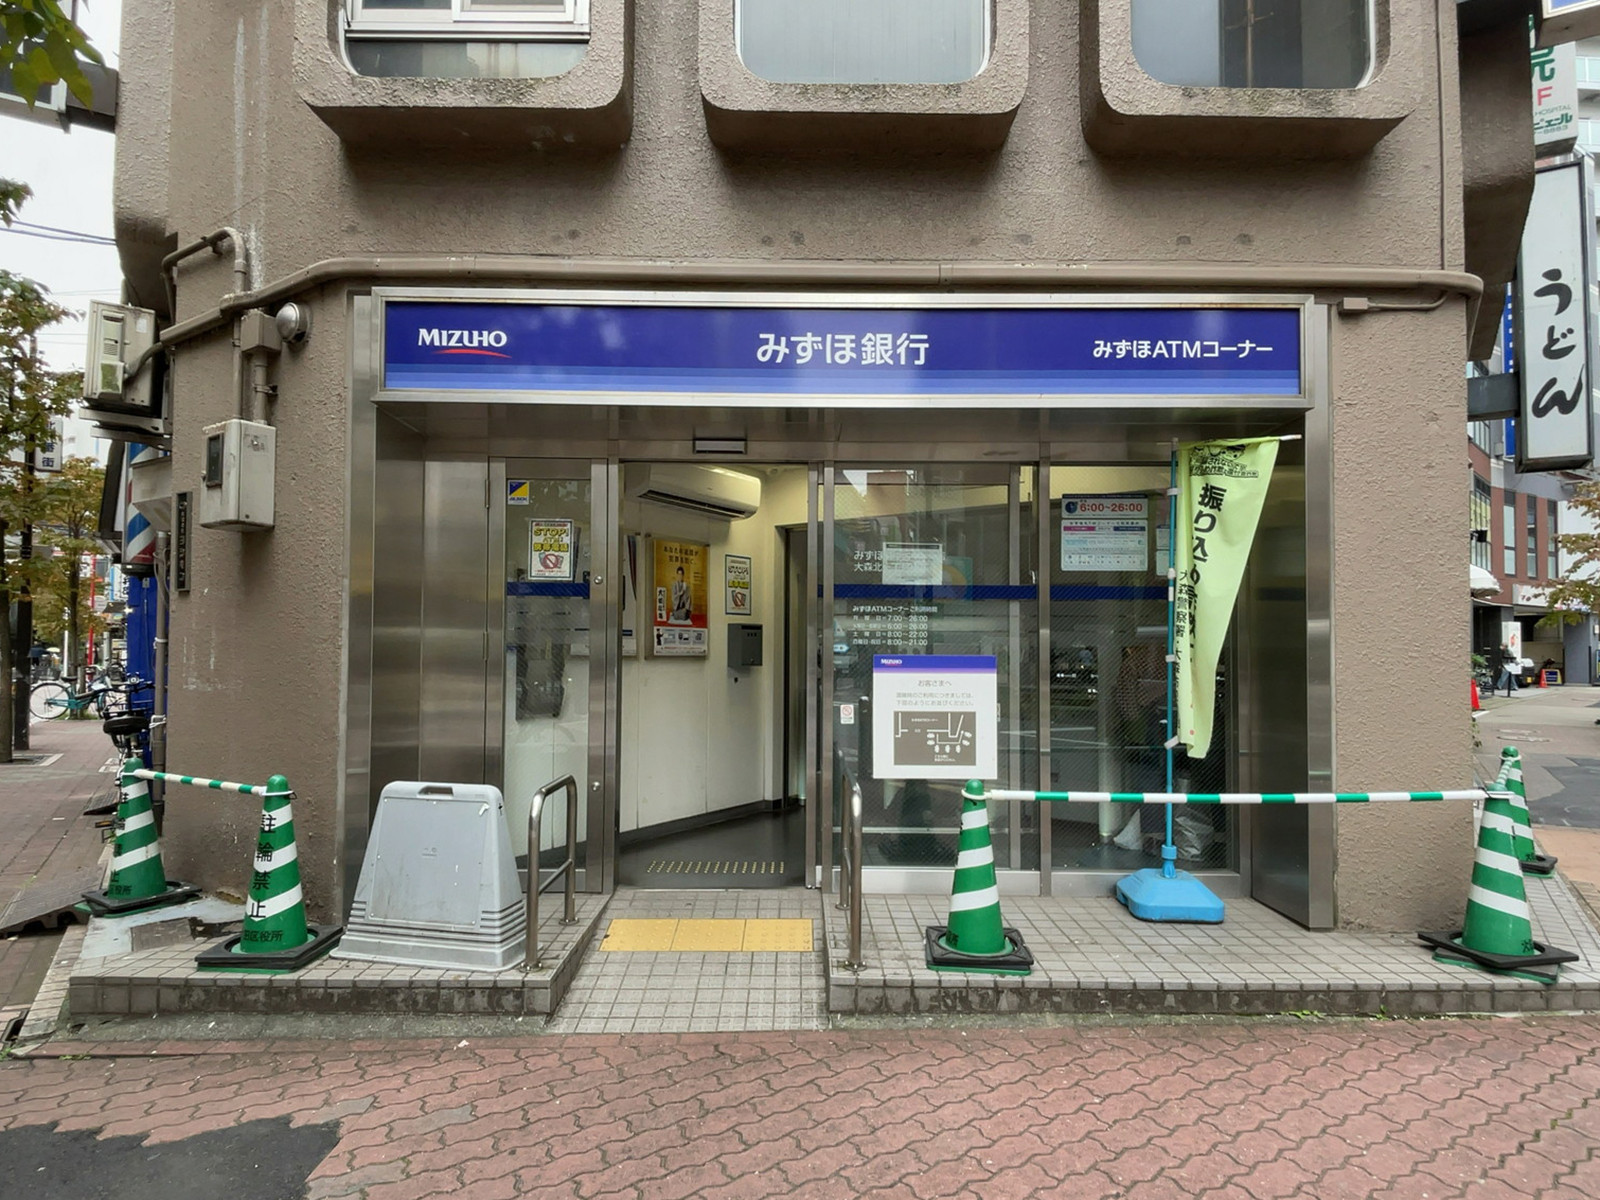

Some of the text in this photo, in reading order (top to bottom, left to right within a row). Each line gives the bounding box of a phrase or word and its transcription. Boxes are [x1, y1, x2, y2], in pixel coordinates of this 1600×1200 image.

[1535, 105, 1572, 116] HOSPITAL
[417, 328, 508, 348] MIZUHO
[756, 332, 929, 366] みずほ銀行
[1092, 339, 1274, 359] みずほATMコーナー
[1532, 268, 1585, 418] うどん
[249, 814, 277, 918] 駐輪禁止
